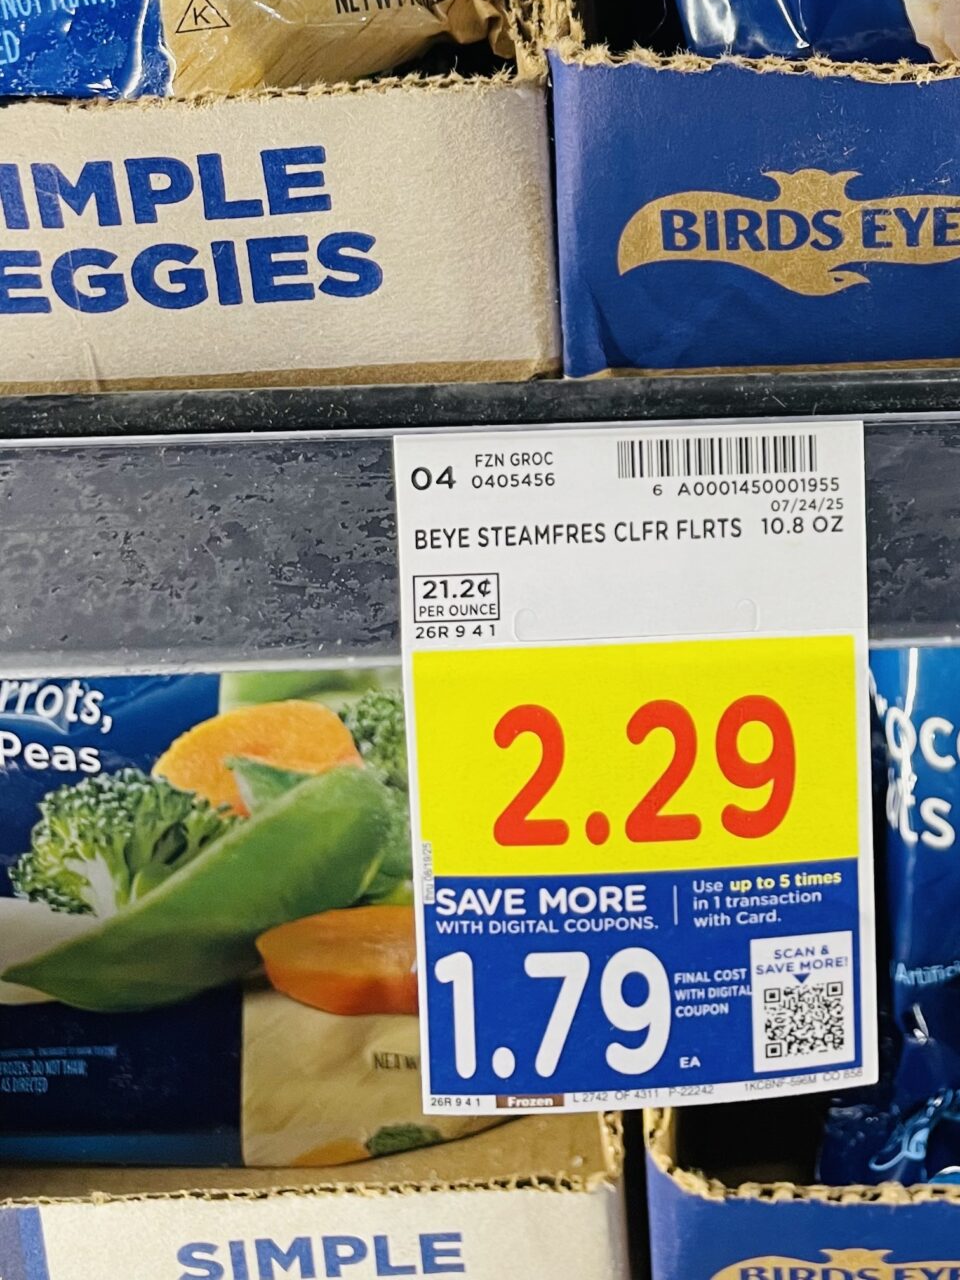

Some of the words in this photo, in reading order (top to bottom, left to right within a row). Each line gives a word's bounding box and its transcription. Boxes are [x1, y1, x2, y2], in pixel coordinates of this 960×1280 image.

[660, 206, 846, 253] BIRDS
[474, 452, 505, 468] FZN
[510, 451, 554, 467] GROC
[410, 465, 457, 491] 04
[471, 472, 556, 490] 0405456
[652, 483, 663, 497] 6
[678, 477, 840, 497] A0001450001955
[771, 497, 845, 513] 07/24/25
[414, 527, 470, 550] BEYE
[477, 523, 607, 548] STEAMFRES
[613, 519, 670, 543] CLFR
[676, 517, 743, 540] FLRTS
[760, 516, 805, 536] 10.8
[812, 515, 845, 534] OZ
[421, 577, 493, 601] 21.2¢
[418, 604, 446, 619] PER
[448, 602, 497, 618] OUNCE
[415, 625, 449, 640] 26R
[455, 624, 465, 639] 9
[472, 624, 483, 638] 4
[490, 623, 496, 637] 1
[493, 694, 796, 846] 2.29
[692, 880, 723, 893] Use
[729, 878, 752, 893] up
[756, 876, 775, 890] to
[779, 874, 791, 888] 5
[795, 872, 843, 885] times
[436, 887, 527, 916] SAVE
[538, 884, 648, 915] MORE
[692, 897, 708, 910] in
[713, 896, 721, 909] 1
[725, 891, 823, 908] transaction
[436, 920, 483, 934] WITH
[488, 919, 560, 934] DIGITAL
[563, 916, 659, 933] COUPONS.
[693, 913, 731, 927] with
[735, 910, 782, 925] Card.
[773, 946, 816, 960] SCAN
[821, 945, 830, 956] &
[755, 962, 794, 975] SAVE
[800, 957, 848, 972] MORE!
[674, 972, 711, 985] FINAL
[713, 969, 747, 982] COST
[674, 988, 705, 1001] WITH
[707, 985, 753, 999] DIGITAL
[434, 947, 672, 1078] 1.79
[674, 1003, 729, 1017] COUPON
[679, 1056, 701, 1068] EA
[431, 1098, 452, 1107] 26R
[465, 1098, 472, 1106] 4
[507, 1096, 554, 1107] Frozen
[176, 1232, 466, 1280] SIMPLE
